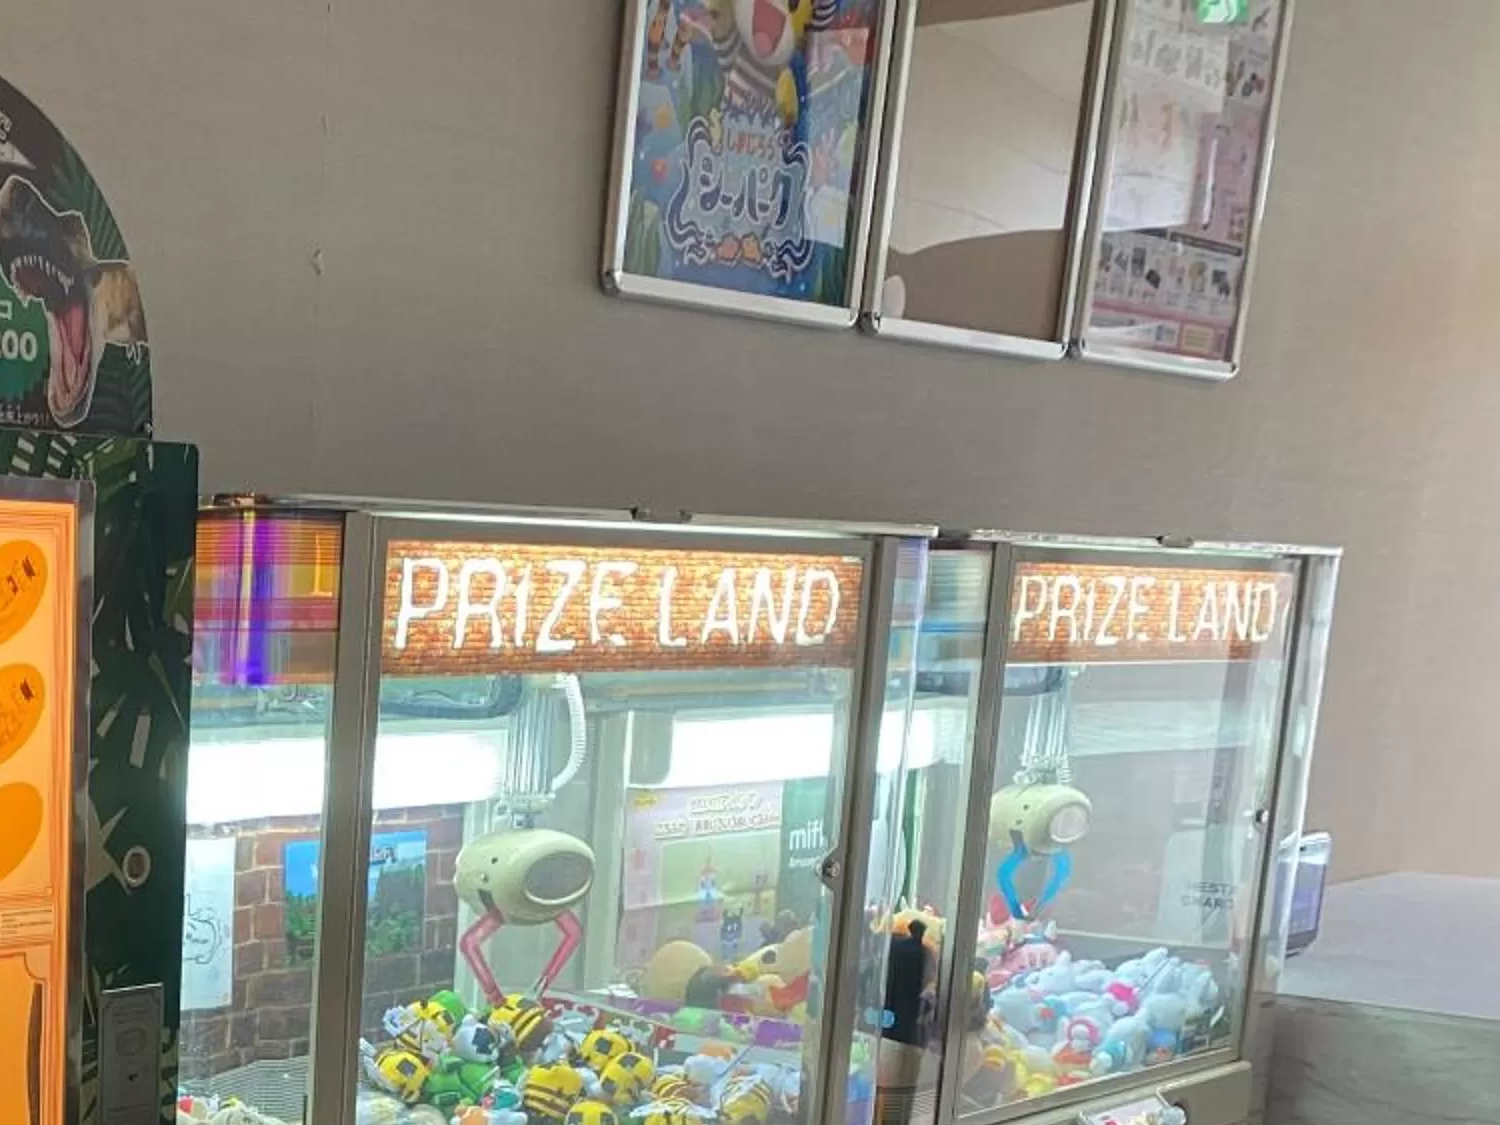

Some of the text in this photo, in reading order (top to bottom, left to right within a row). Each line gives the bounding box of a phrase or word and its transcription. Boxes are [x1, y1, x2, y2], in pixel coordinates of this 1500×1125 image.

[391, 555, 842, 653] PRIZE LAND
[1012, 574, 1280, 646] PRIZE LAND
